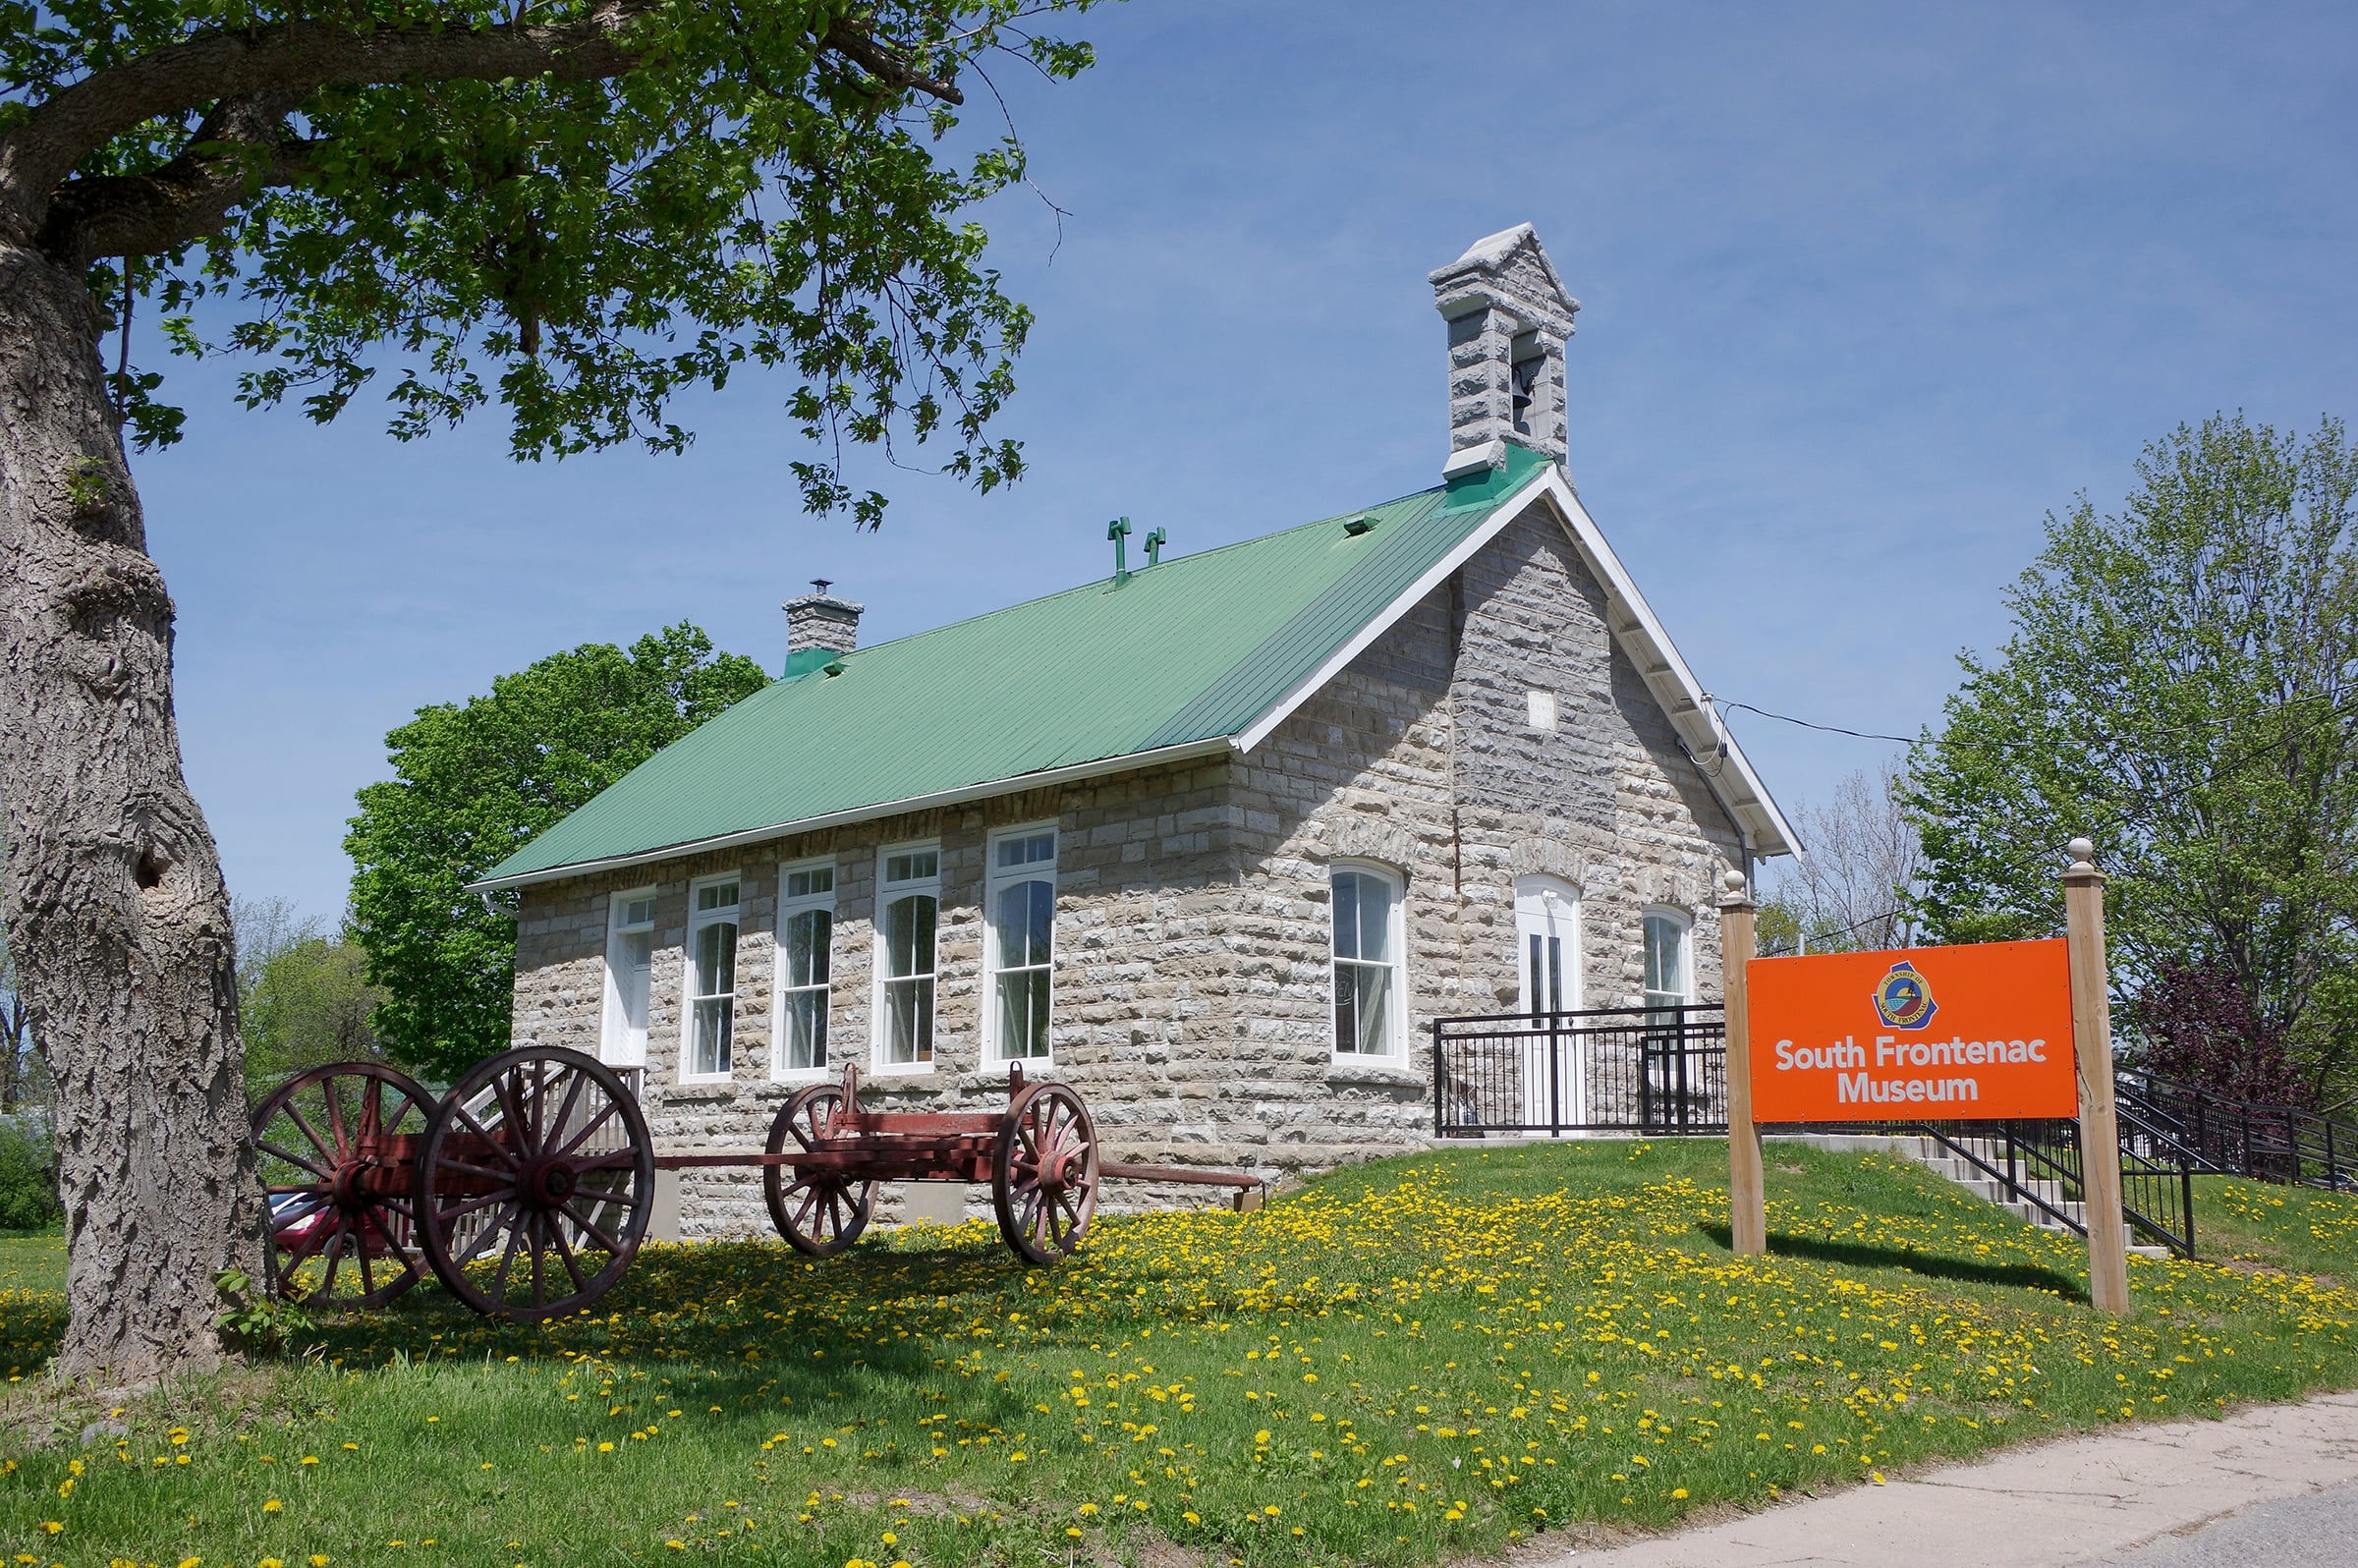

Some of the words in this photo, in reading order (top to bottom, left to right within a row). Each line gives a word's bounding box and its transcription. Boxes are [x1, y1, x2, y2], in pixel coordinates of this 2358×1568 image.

[1884, 972, 1914, 985] TOWNSHIP
[1881, 1002, 1896, 1022] SOUTH
[1897, 1001, 1928, 1023] FRONTENAC
[1775, 1036, 1865, 1070] South
[1876, 1036, 2047, 1067] Frontenac
[1838, 1073, 1979, 1103] Museum
